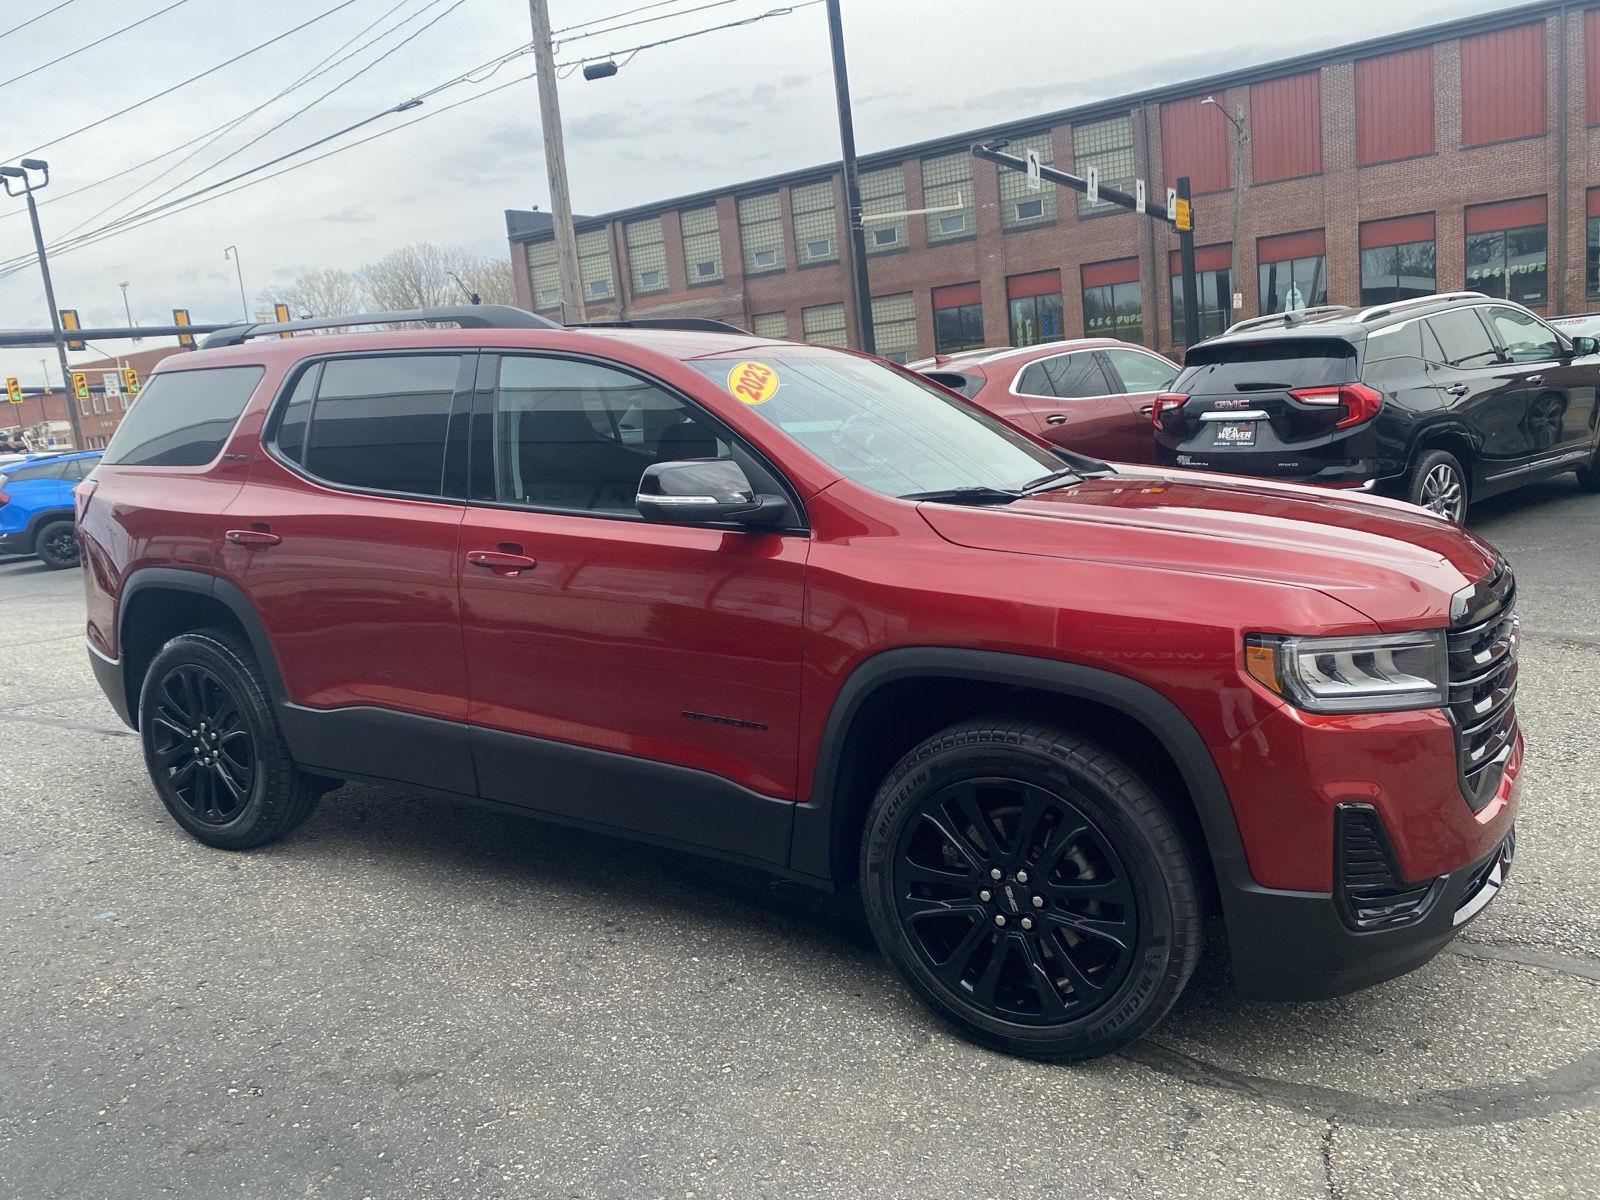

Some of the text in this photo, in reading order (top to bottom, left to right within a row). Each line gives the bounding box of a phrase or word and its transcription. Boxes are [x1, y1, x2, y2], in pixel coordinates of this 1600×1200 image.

[736, 363, 770, 401] 2023
[1214, 399, 1250, 409] GMC
[1218, 431, 1252, 441] WEAVER
[878, 770, 929, 838] MICHELIN
[1090, 973, 1153, 1041] MICHELIN
